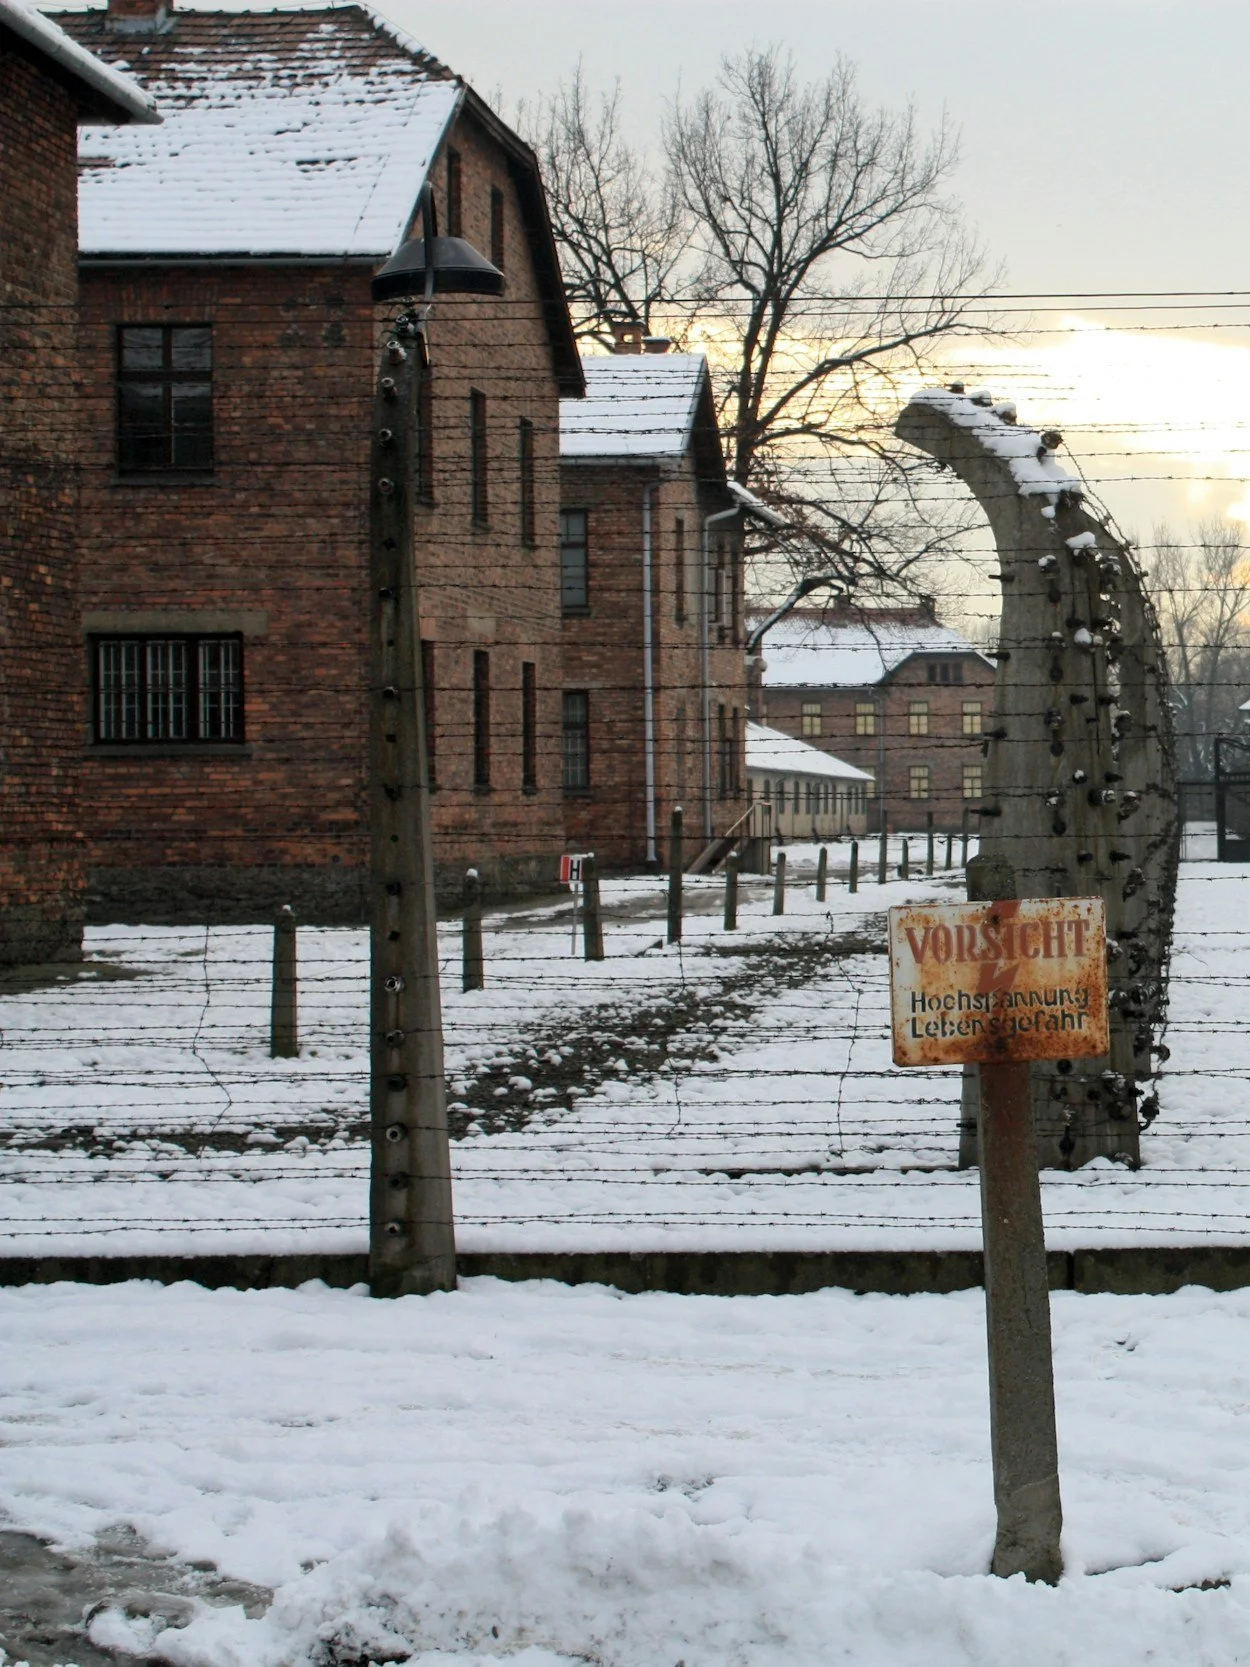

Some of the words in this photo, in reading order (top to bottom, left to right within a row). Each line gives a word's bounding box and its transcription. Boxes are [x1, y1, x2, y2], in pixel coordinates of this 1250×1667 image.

[570, 860, 580, 880] H
[905, 919, 1090, 964] VORSICHT
[911, 986, 1089, 1013] Hochspannung
[911, 1009, 1090, 1038] Lebensgefahr
